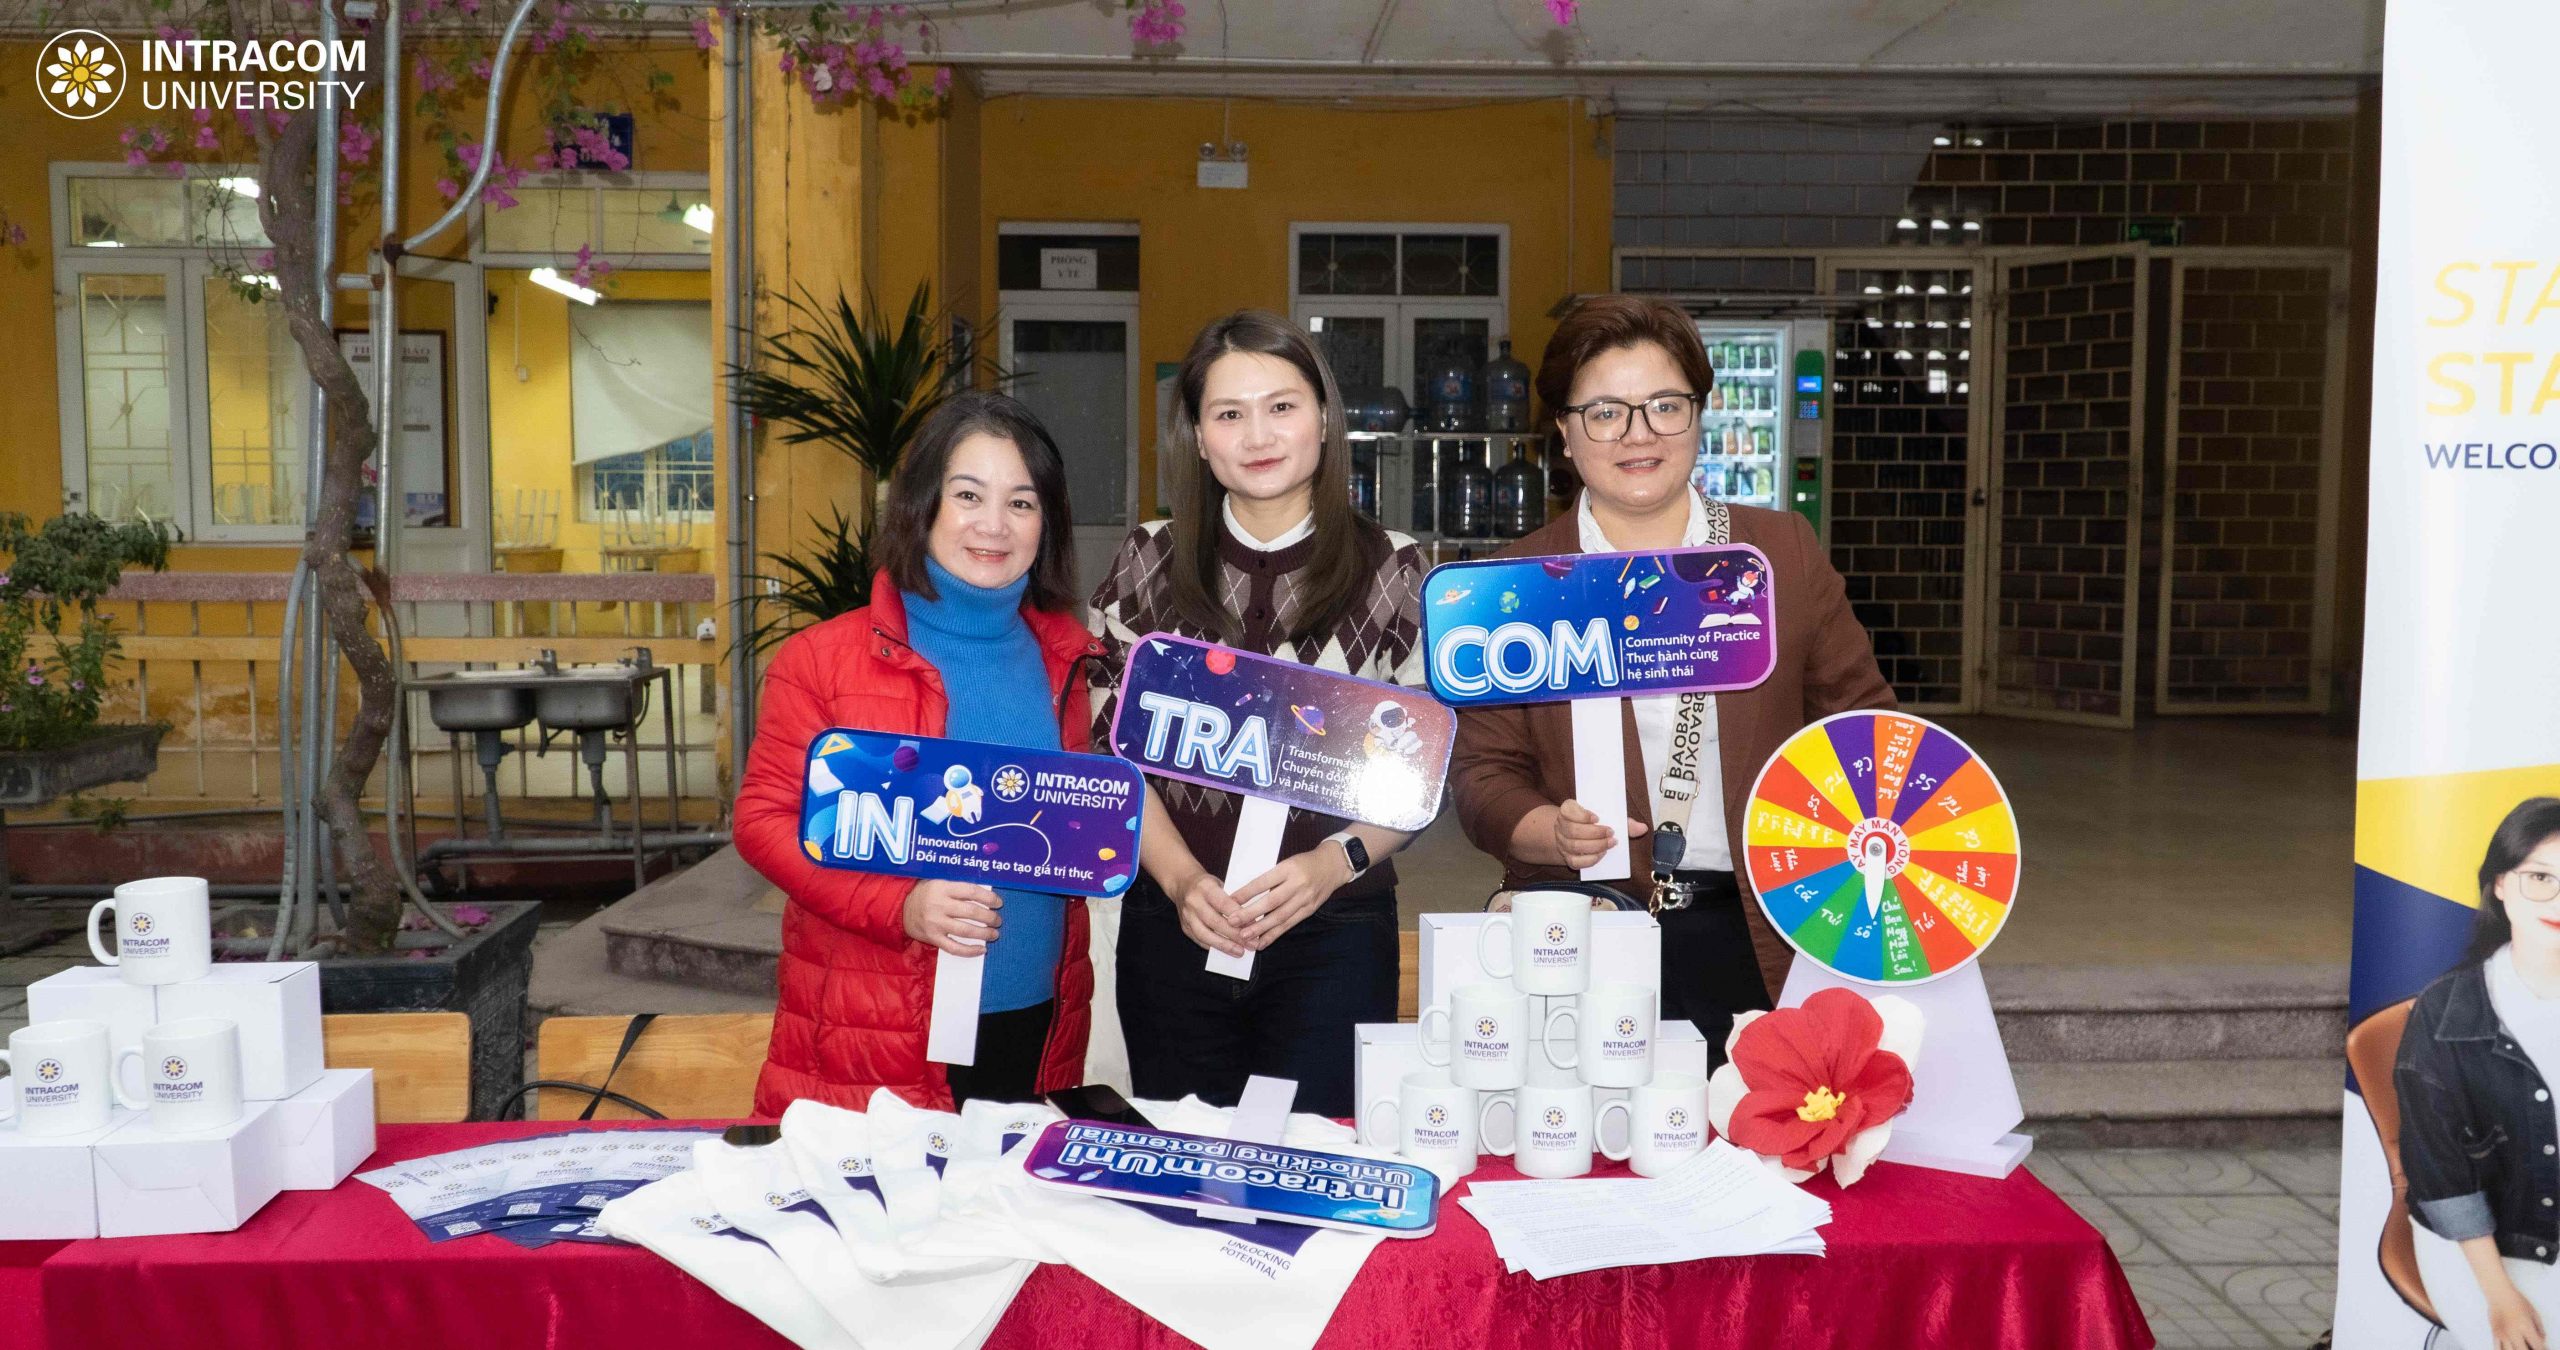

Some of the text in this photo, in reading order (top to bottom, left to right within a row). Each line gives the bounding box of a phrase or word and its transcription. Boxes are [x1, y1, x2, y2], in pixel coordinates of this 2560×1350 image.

[2424, 443, 2560, 469] WELCO
[1625, 630, 1761, 648] Community of Practice
[1435, 618, 1619, 696] COM
[1626, 648, 1719, 665] Thực hành cùng
[1627, 665, 1694, 681] hệ sinh thái
[1140, 691, 1273, 788] TRA
[1281, 760, 1323, 779] Chuyển
[1035, 772, 1130, 796] INTRACOM
[1278, 776, 1291, 788] và
[1292, 779, 1319, 793] phát
[1033, 789, 1127, 811] UNIVERSITY
[833, 790, 914, 865] IN
[1850, 823, 1867, 848] MAY
[917, 835, 978, 851] Innovation
[915, 850, 1094, 880] Đổi mới sáng tạo tạo giá trị thực
[122, 938, 170, 946] INTRACOM
[1533, 947, 1578, 956] INTRACOM
[1464, 1040, 1509, 1050] INTRACOM
[1602, 1040, 1647, 1049] INTRACOM
[25, 1083, 79, 1095] INTRACOM
[153, 1081, 203, 1091] INTRACOM
[1414, 1128, 1459, 1137] INTRACOM
[1532, 1131, 1577, 1140] INTRACOM
[1654, 1131, 1698, 1141] INTRACOM
[1066, 1125, 1414, 1188] Unlocking potential
[1059, 1142, 1409, 1210] IntracomUni
[1220, 1246, 1277, 1281] POTENTIAL
[1227, 1239, 1291, 1271] UNLOCKING
